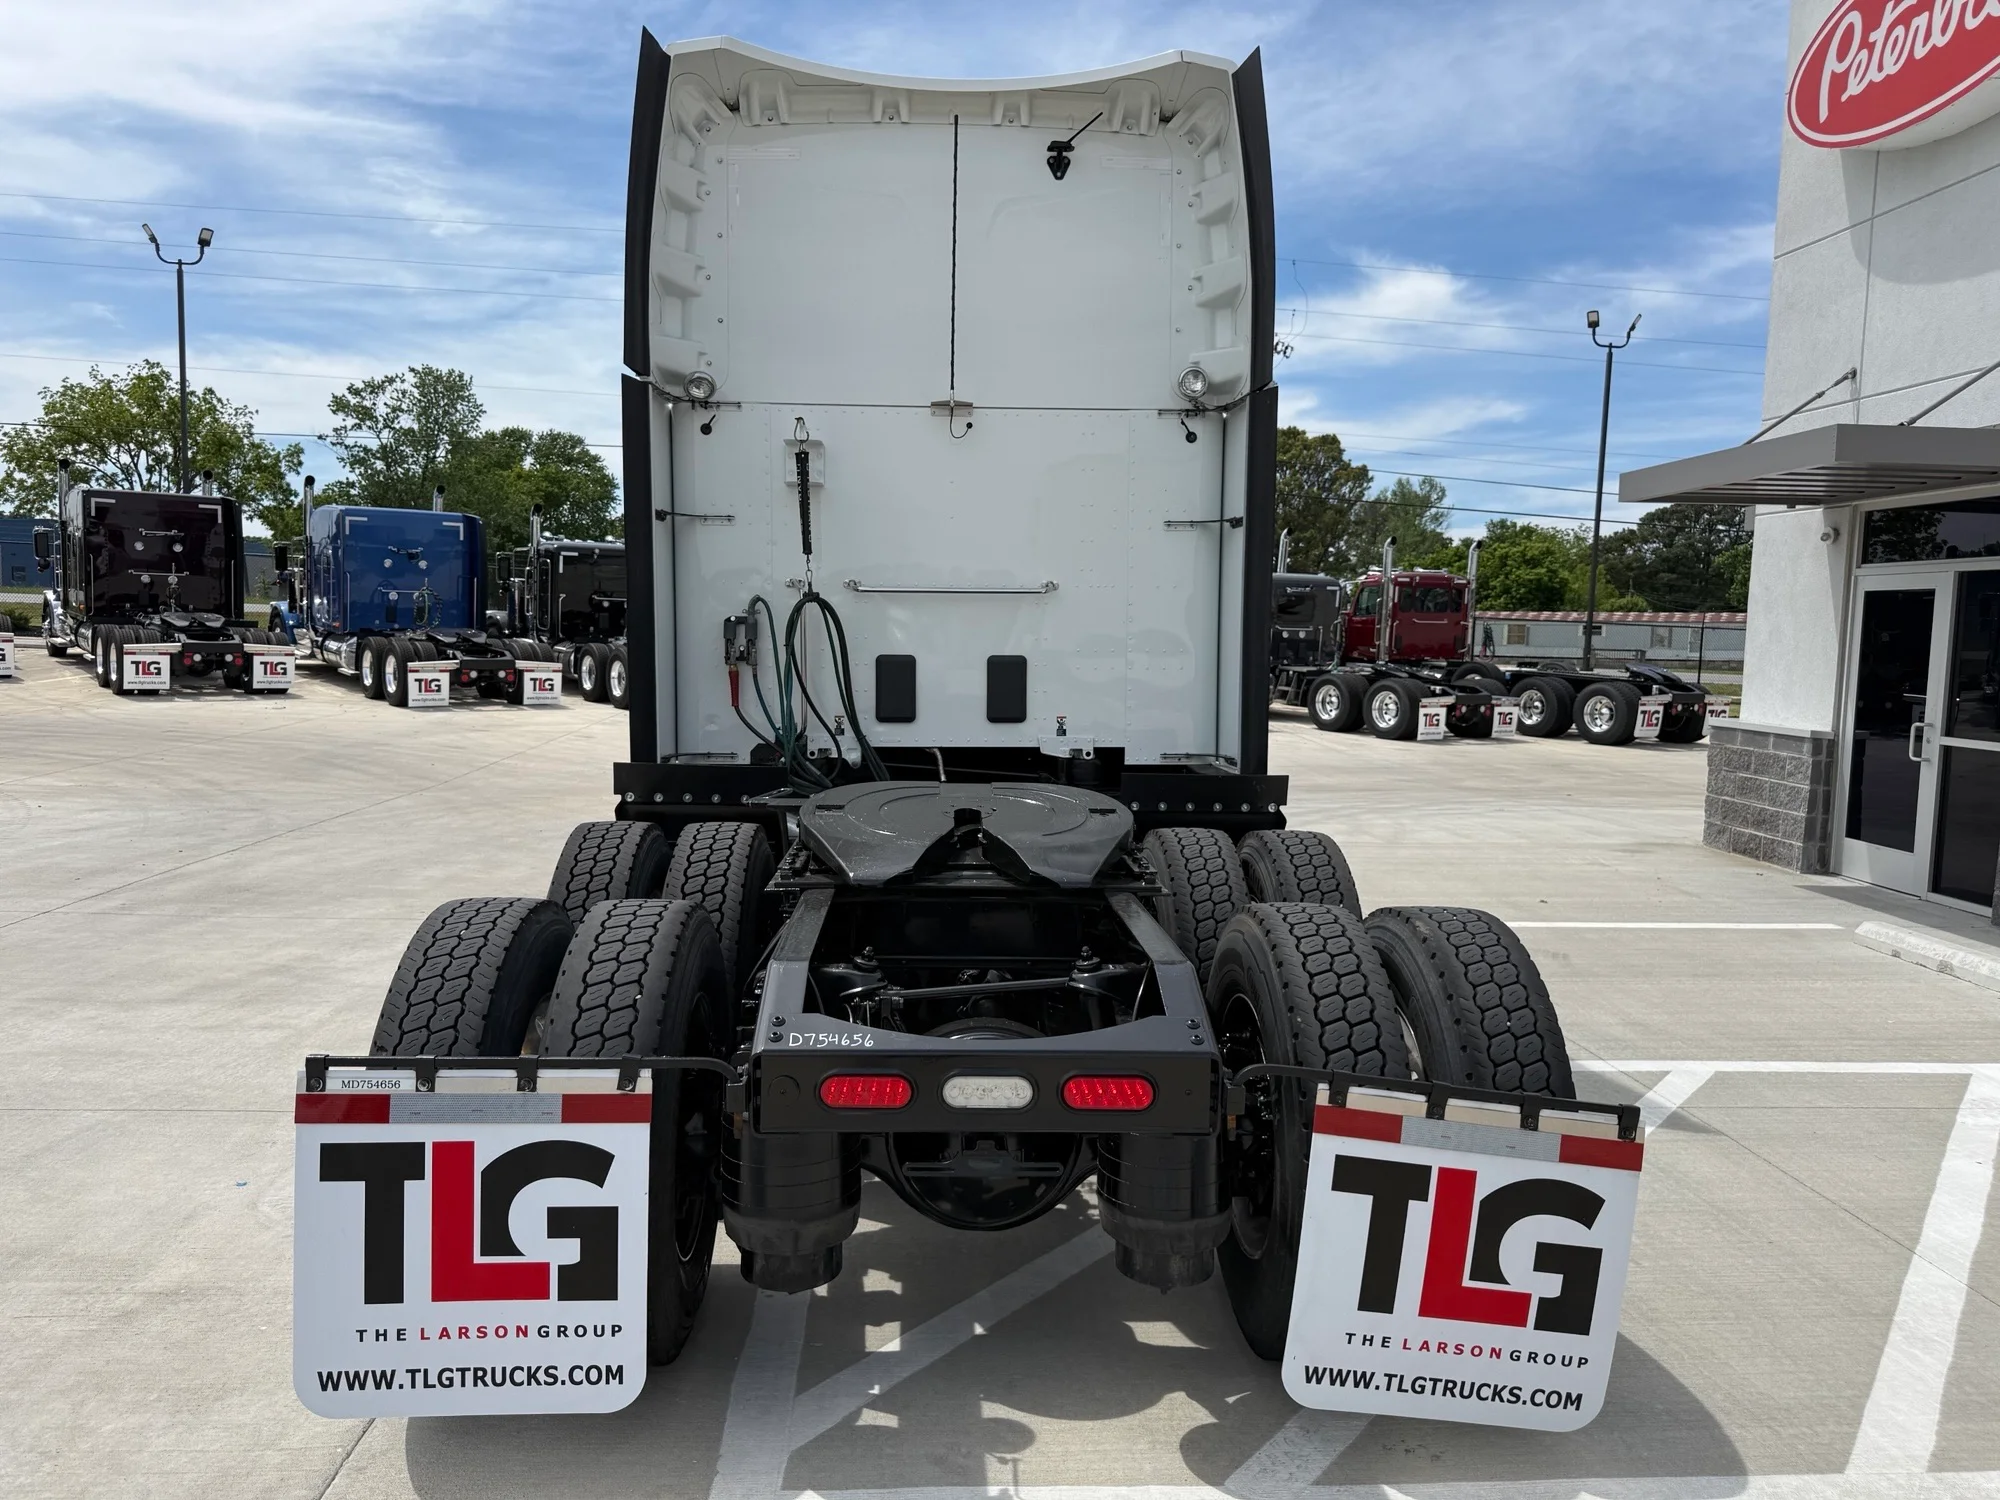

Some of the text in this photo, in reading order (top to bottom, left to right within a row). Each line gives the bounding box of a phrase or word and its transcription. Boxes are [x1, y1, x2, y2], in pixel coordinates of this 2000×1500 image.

[1819, 0, 2000, 123] Peterb
[130, 660, 162, 676] TLG
[259, 661, 288, 676] TLG
[414, 678, 441, 693] TLG
[529, 677, 554, 692] TLG
[1422, 712, 1441, 727] TLG
[1497, 712, 1513, 725] TLG
[1639, 709, 1661, 728] TLG
[788, 1032, 874, 1049] D754656
[341, 1079, 401, 1090] MD754656
[319, 1139, 619, 1304] TLG
[1331, 1154, 1606, 1336] TLG
[355, 1327, 407, 1342] THE
[1345, 1332, 1392, 1349] THE
[317, 1364, 624, 1392] WWW.TLGTRUCKS.COM
[1304, 1365, 1583, 1411] WWW.TLGTRUCKS.COM
